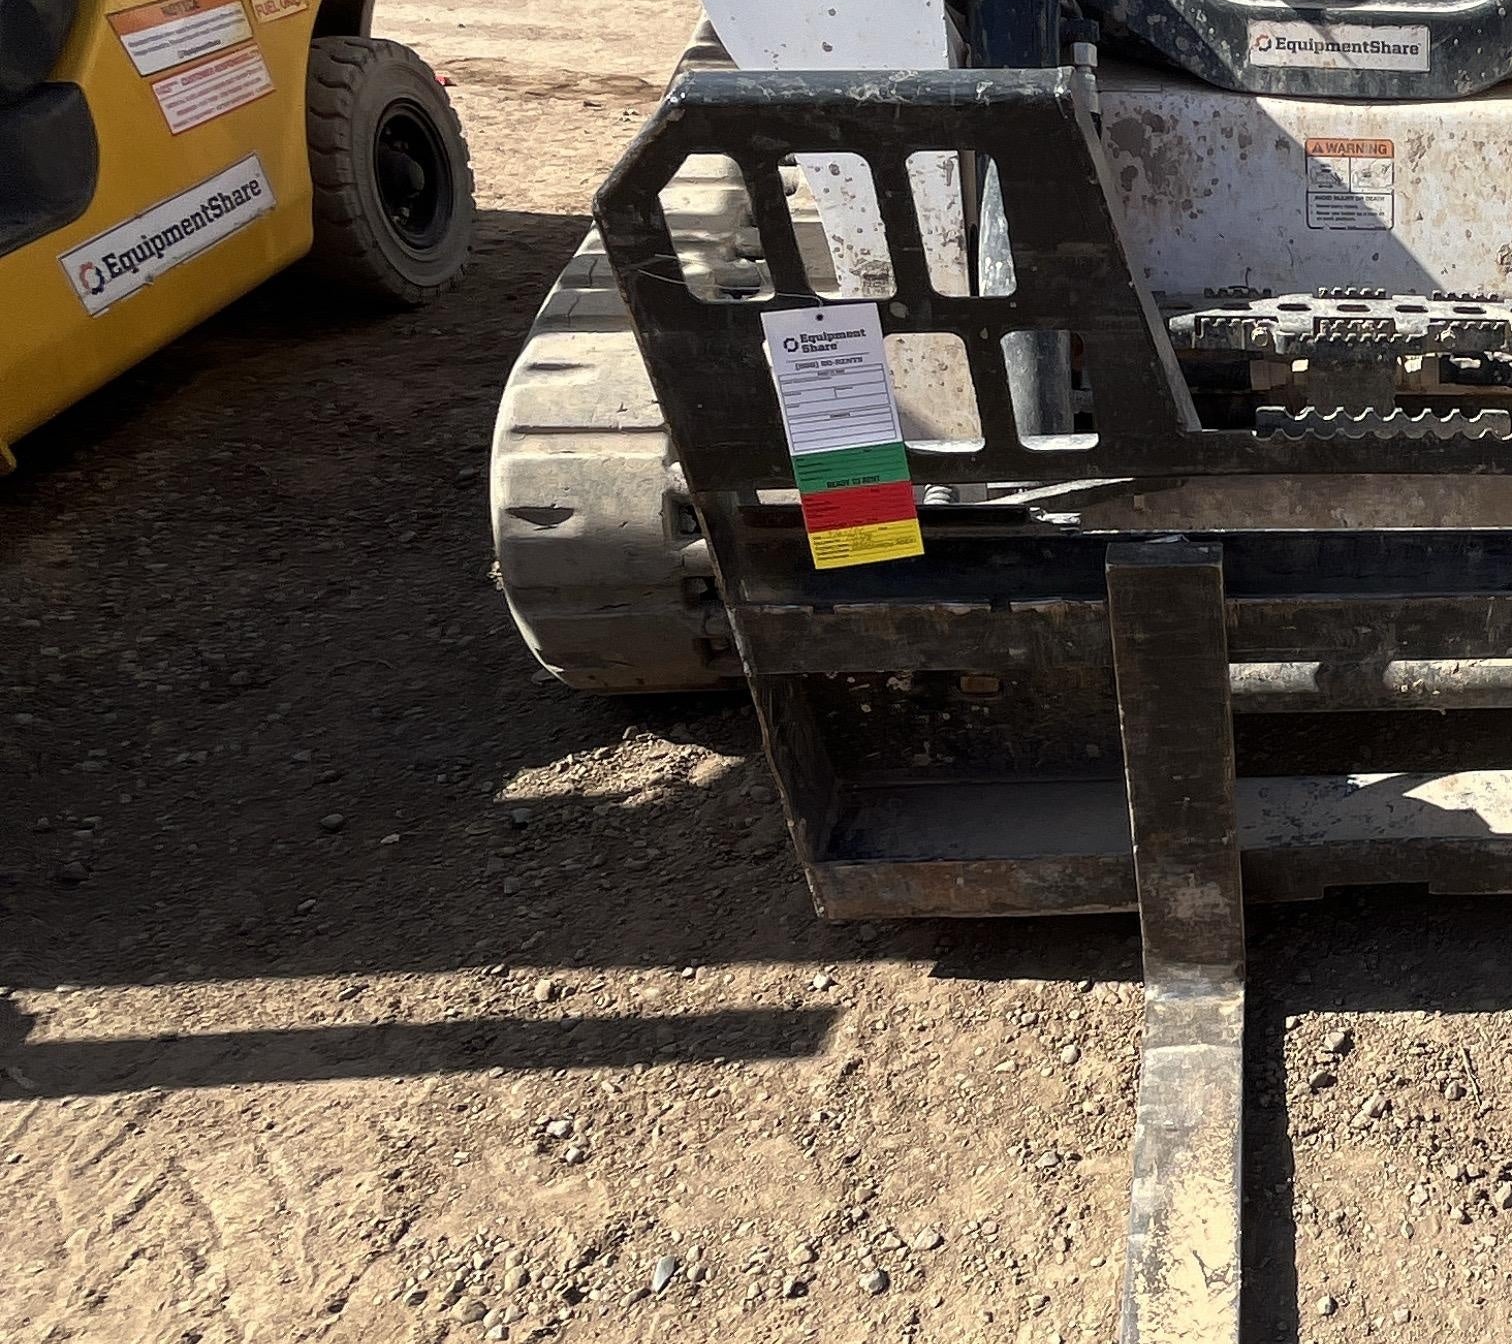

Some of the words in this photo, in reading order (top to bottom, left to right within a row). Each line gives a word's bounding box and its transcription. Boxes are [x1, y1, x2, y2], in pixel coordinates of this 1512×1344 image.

[255, 0, 278, 18] FUEL
[1275, 37, 1420, 56] EquipmentShare
[1325, 142, 1388, 155] WARNING
[102, 178, 262, 279] EquipmentShare
[800, 328, 867, 343] Equipment
[801, 343, 838, 353] Share
